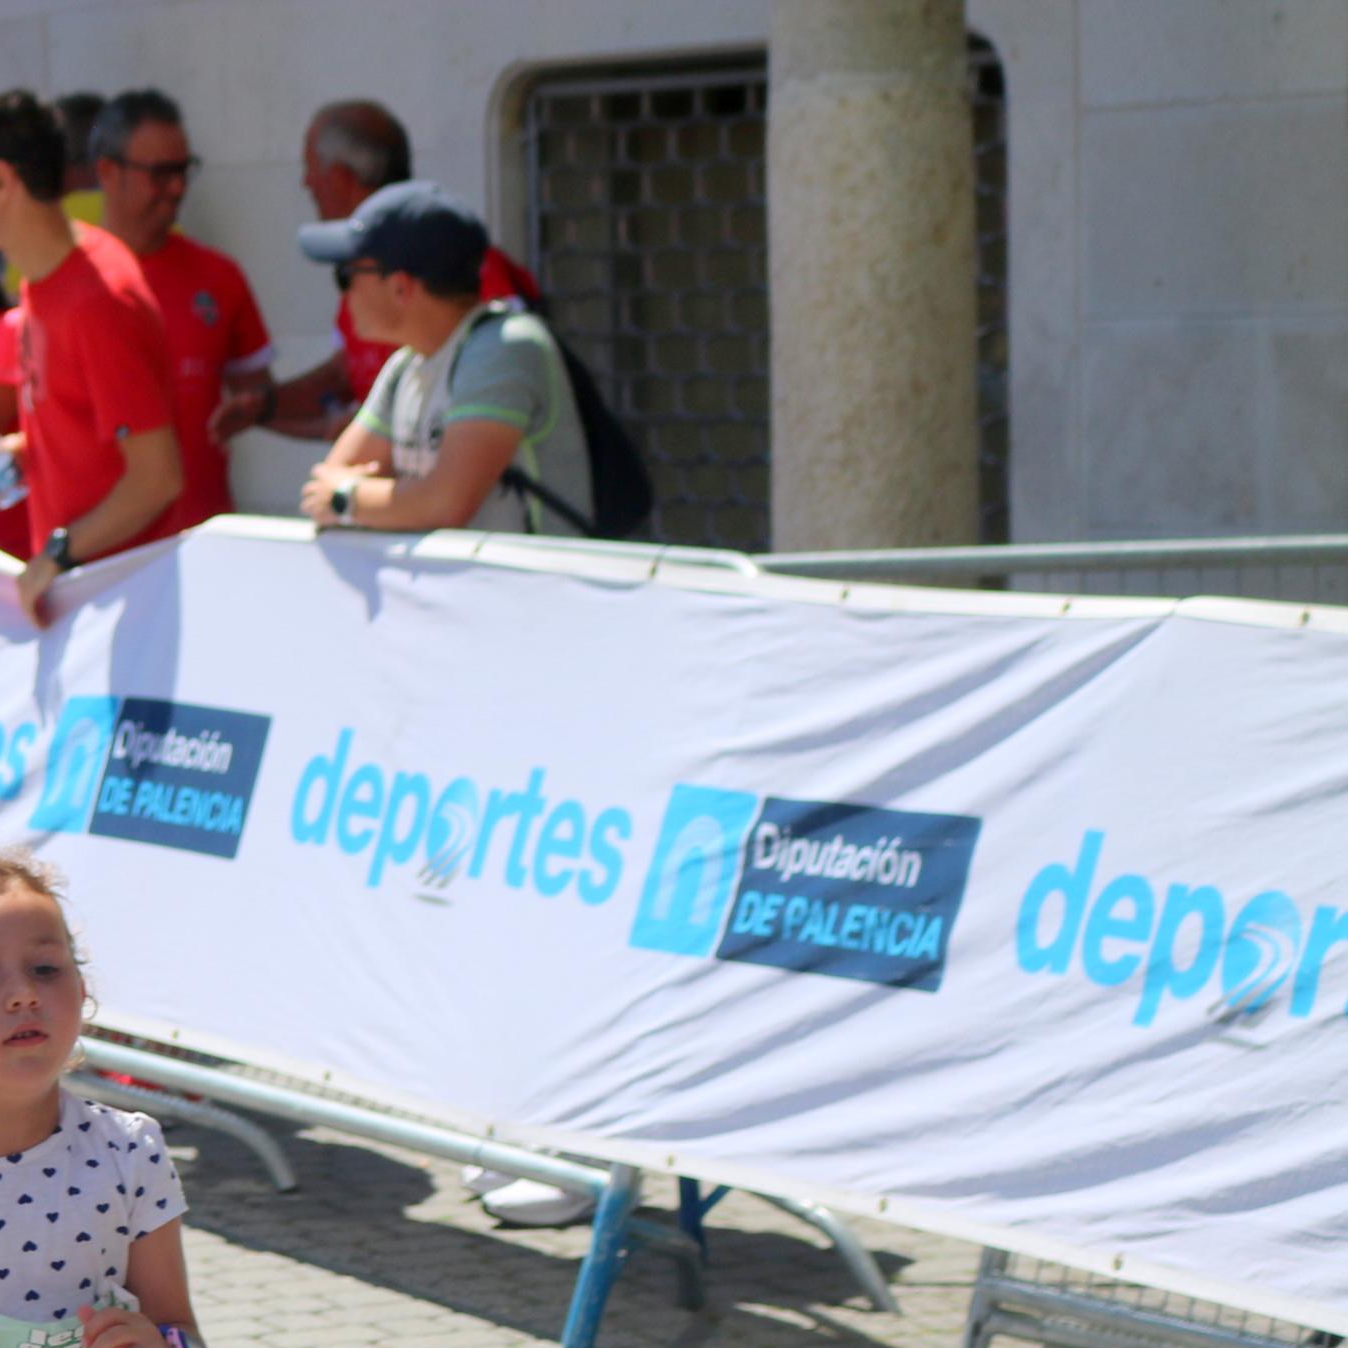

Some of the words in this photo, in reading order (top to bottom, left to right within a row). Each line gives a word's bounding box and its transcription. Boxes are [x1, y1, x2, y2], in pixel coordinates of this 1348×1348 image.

[113, 718, 233, 774] Diputación
[98, 775, 133, 813] DE
[133, 780, 244, 834] PALENCIA
[291, 727, 632, 906] deportes
[754, 822, 921, 887] Diputación
[732, 891, 784, 936] DE
[782, 896, 943, 960] PALENCIA
